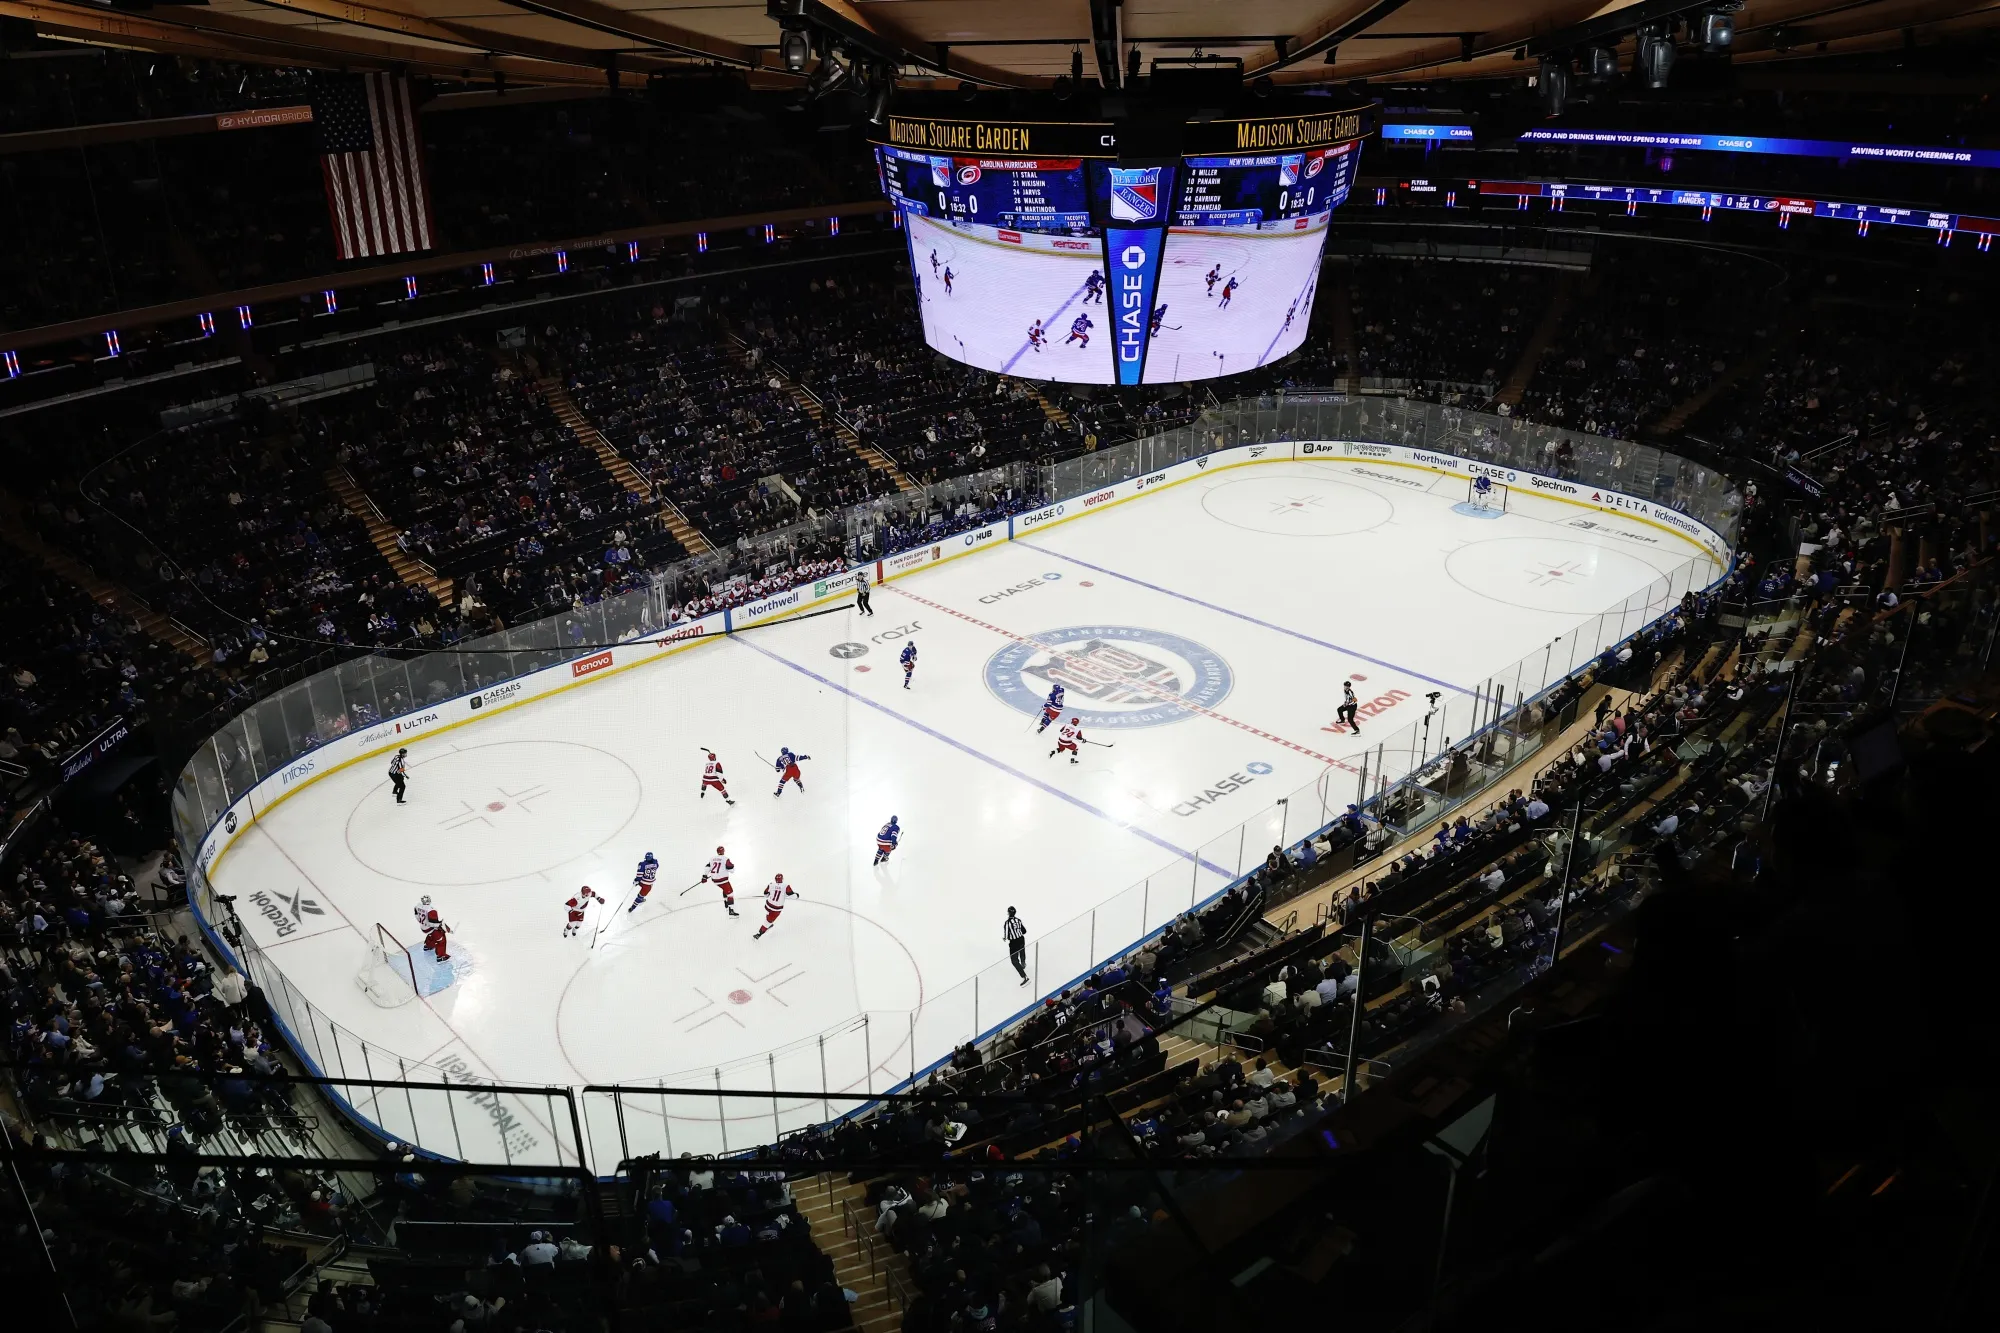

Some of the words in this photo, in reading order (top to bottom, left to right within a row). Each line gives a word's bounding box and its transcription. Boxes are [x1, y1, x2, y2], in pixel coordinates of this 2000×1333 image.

[238, 114, 280, 126] HYUNDAI
[890, 118, 926, 145] MADISON
[930, 122, 972, 149] SQUARE
[976, 125, 1029, 150] GARDEN
[1237, 122, 1294, 148] MADISON
[1296, 118, 1332, 143] SQUARE
[1334, 114, 1360, 138] GARDEN
[1718, 139, 1744, 148] CHASE
[1256, 157, 1277, 165] RANGERS
[1851, 146, 1884, 156] SAVINGS
[1886, 148, 1914, 158] WORTH
[1916, 150, 1954, 161] CHEERING
[1955, 153, 1972, 161] FOR
[980, 160, 1004, 168] CAROLINA
[1114, 175, 1132, 183] NEW
[1135, 174, 1156, 183] YORK
[938, 192, 946, 210] 0
[969, 195, 978, 213] 0
[1120, 188, 1155, 215] RANGERS
[1280, 191, 1288, 210] 0
[1307, 187, 1314, 205] 0
[1678, 196, 1705, 205] RANGERS
[1727, 197, 1732, 206] 0
[1753, 199, 1759, 208] 0
[1780, 205, 1812, 214] HURRICANES
[1927, 219, 1948, 228] 100.0%
[524, 246, 562, 256] LEXUS
[573, 240, 593, 248] SUITE
[1053, 240, 1091, 250] verizon
[1120, 274, 1143, 362] CHASE
[1413, 452, 1457, 468] Northwell
[1146, 473, 1166, 486] PEPSI
[1351, 467, 1418, 487] Spectrum
[1468, 464, 1505, 479] CHASE
[1531, 476, 1574, 493] Spectrum
[1083, 490, 1114, 507] verizon
[1606, 495, 1648, 514] DELTA
[1024, 508, 1055, 525] CHASE
[1654, 509, 1701, 536] ticketmaster
[976, 530, 993, 542] HUB
[820, 570, 868, 592] enterprie
[978, 578, 1046, 605] CHASE
[748, 592, 798, 617] Northwell
[656, 625, 704, 648] verizon
[872, 620, 923, 644] razr
[1052, 628, 1141, 639] RANGERS
[575, 655, 609, 673] Lenovo
[483, 682, 521, 700] CAESARS
[484, 693, 515, 706] SPORTSBOOK
[1081, 713, 1164, 724] MADISON
[1202, 660, 1222, 685] GARDEN
[359, 728, 393, 746] Michelob
[403, 713, 439, 730] ULTRA
[100, 727, 128, 752] ULTRA
[282, 759, 314, 784] Infosys
[1171, 771, 1254, 817] CHASE
[711, 862, 721, 873] 21
[772, 890, 781, 901] 11
[436, 1053, 522, 1134] Northwell
